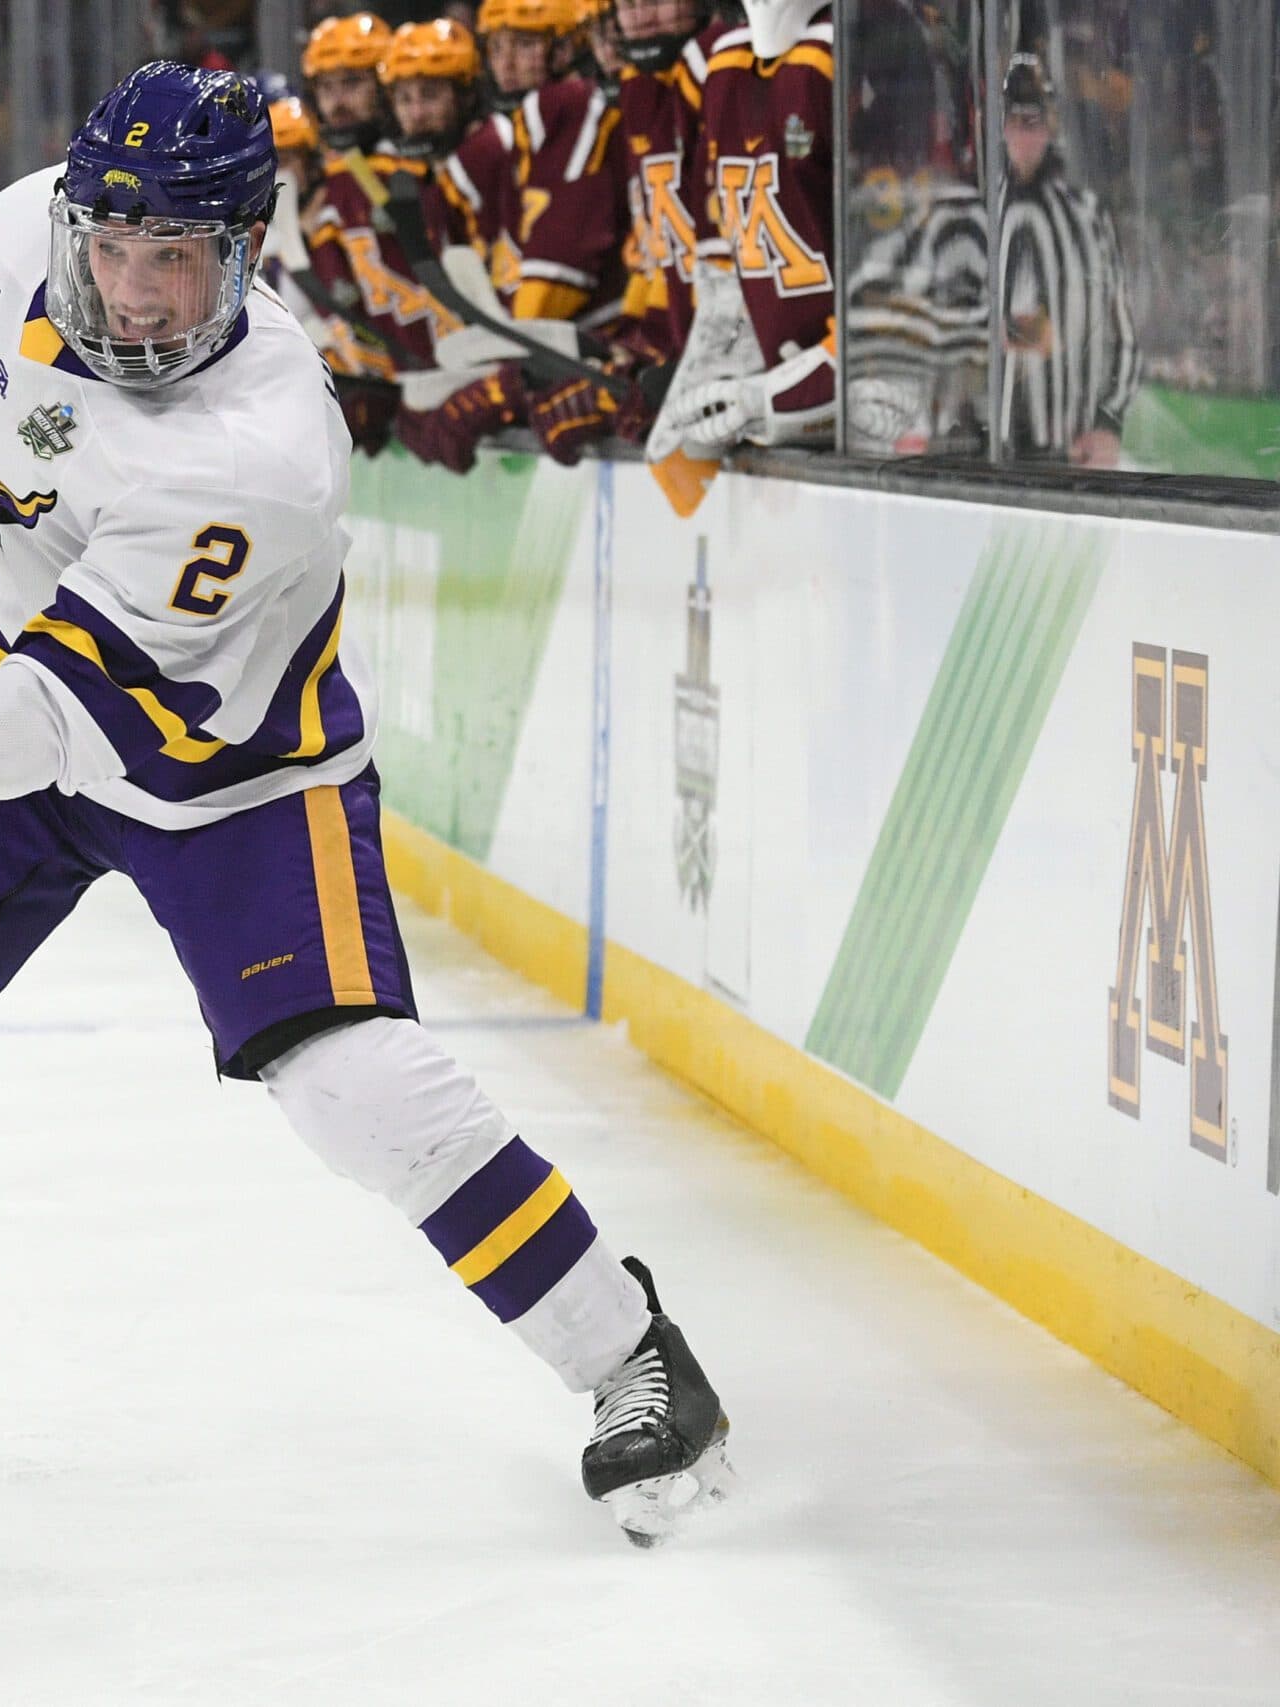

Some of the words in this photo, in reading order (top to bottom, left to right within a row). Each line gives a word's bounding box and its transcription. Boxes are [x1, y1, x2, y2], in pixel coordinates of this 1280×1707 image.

[124, 121, 150, 148] 2
[45, 428, 67, 449] FOUR
[166, 521, 254, 618] 2
[1108, 641, 1228, 1164] M
[241, 953, 295, 980] BAUER
